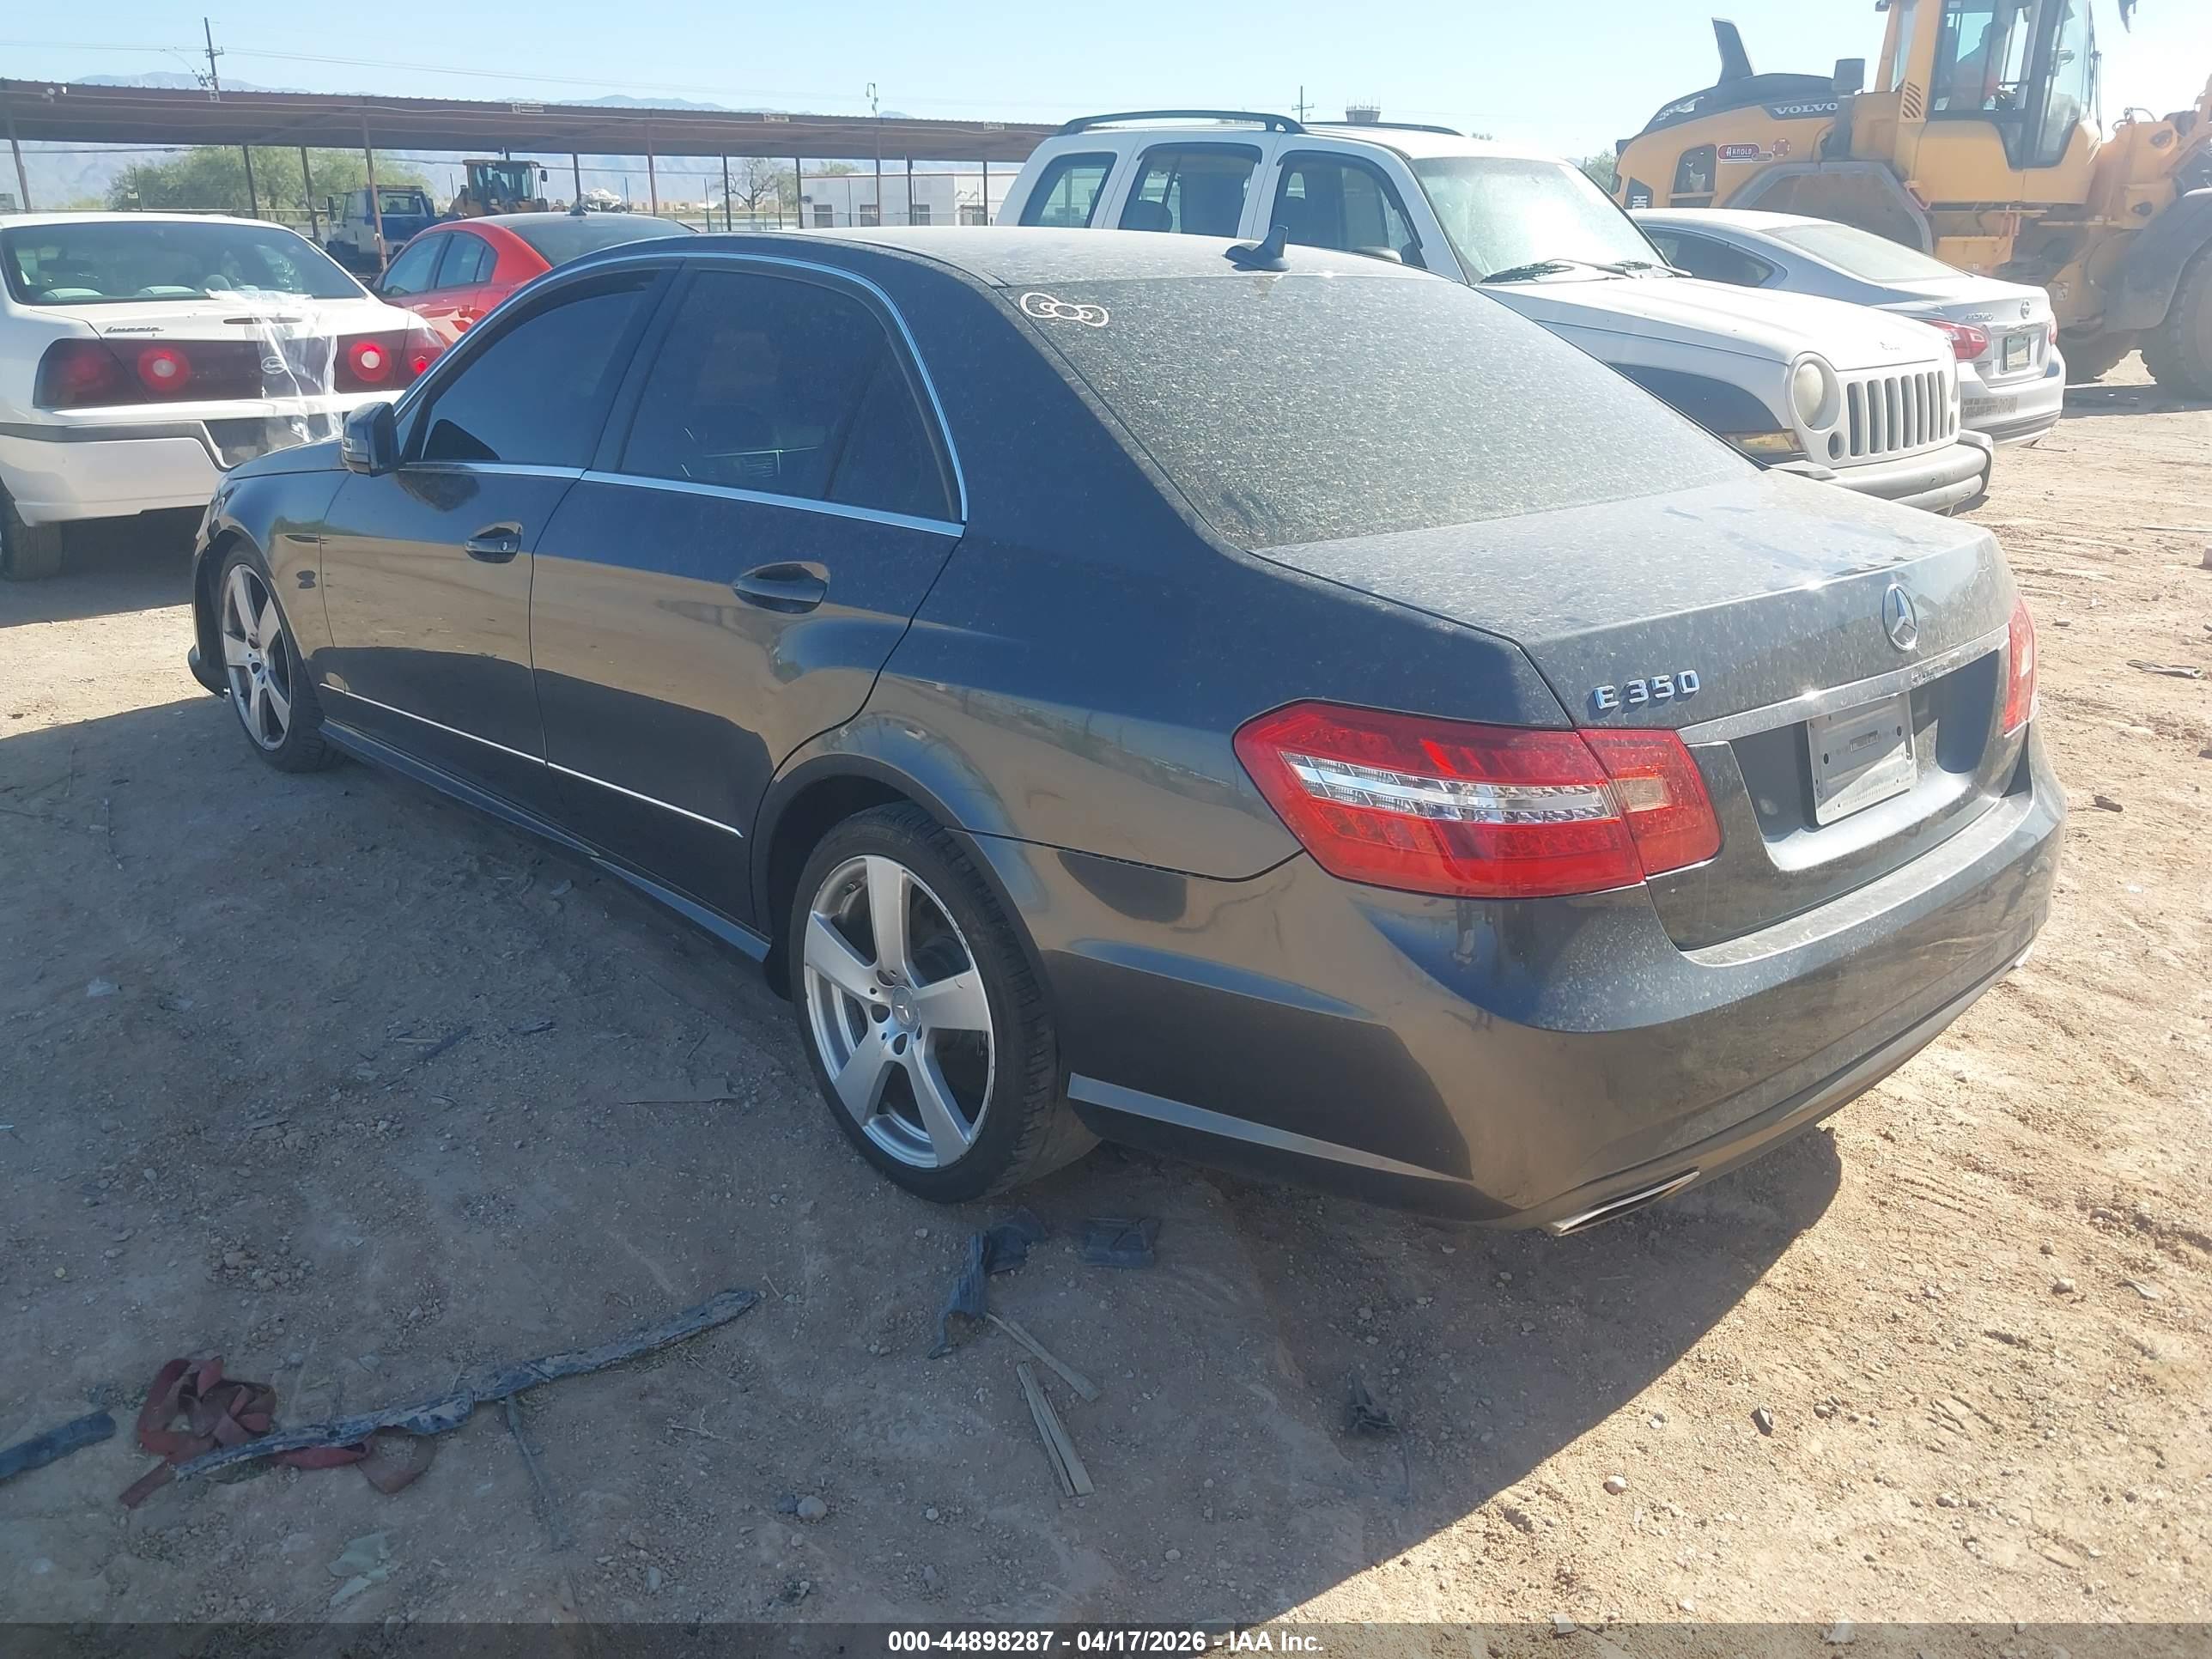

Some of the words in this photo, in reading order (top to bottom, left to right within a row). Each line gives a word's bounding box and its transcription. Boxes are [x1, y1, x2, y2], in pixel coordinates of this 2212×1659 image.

[1773, 102, 1838, 115] VOLVO
[1726, 146, 1753, 157] ARNOLD
[1594, 685, 1620, 709] E
[1626, 669, 1700, 703] 350
